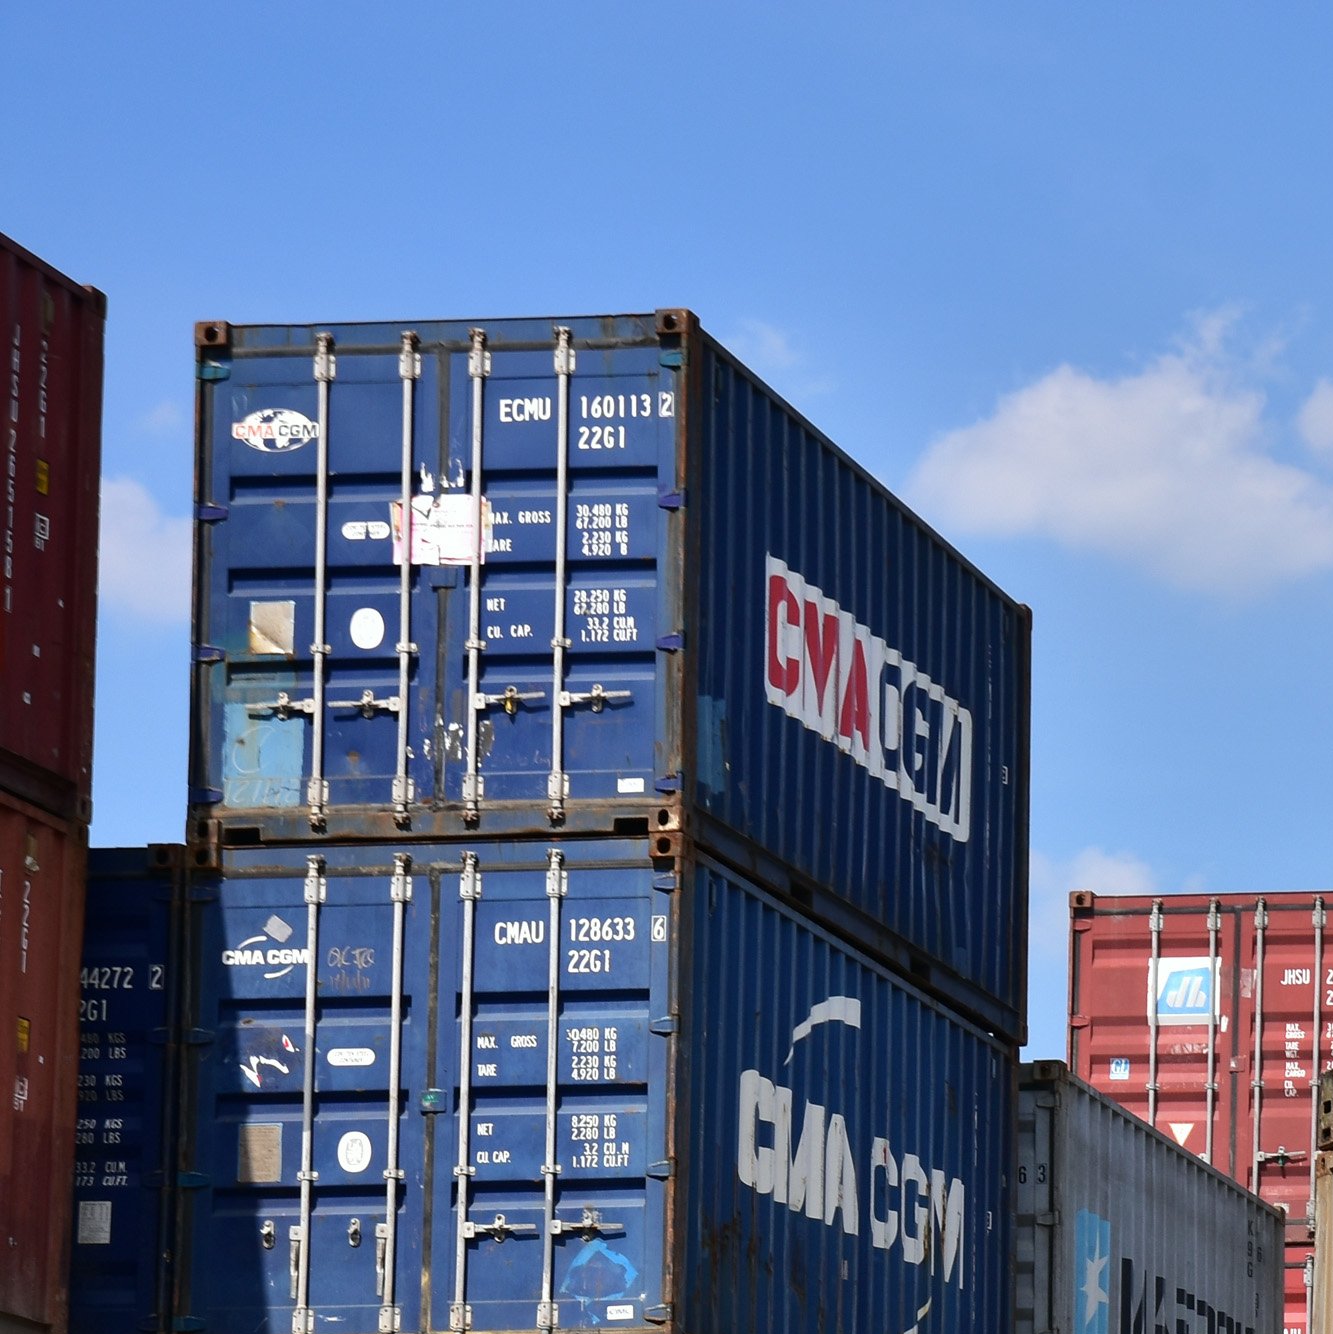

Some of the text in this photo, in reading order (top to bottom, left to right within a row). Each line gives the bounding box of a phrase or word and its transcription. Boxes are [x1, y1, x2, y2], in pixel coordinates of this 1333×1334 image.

[500, 392, 673, 422] ECMU 160113 2
[235, 423, 318, 438] CMA CGM
[578, 426, 626, 449] 22G1
[576, 503, 628, 516] 30.480 KG
[518, 511, 551, 524] GROSS
[576, 516, 628, 529] 67.200 LB
[582, 531, 628, 544] 2.230 KG
[582, 544, 611, 556] 4.920
[574, 589, 626, 602] 28.250 KG
[487, 598, 505, 611] NET
[613, 602, 626, 614] LB
[587, 617, 609, 630] 33.2
[581, 629, 609, 642] 1.172
[494, 917, 665, 944] CMAU 128633 6
[222, 950, 265, 965] CMA
[267, 949, 309, 965] CGM
[567, 949, 610, 973] 22G1
[1280, 968, 1310, 985] JHSU
[604, 1028, 617, 1040] KG
[477, 1035, 537, 1049] MAX. GROSS
[604, 1040, 616, 1052] LB
[571, 1055, 617, 1068] 2.230 KG
[477, 1064, 497, 1077] TARE
[571, 1068, 616, 1081] 4.920 LB
[604, 1115, 617, 1126] KG
[477, 1123, 493, 1135] NET
[603, 1128, 616, 1139] LB
[738, 1068, 859, 1236] CMA
[572, 1155, 598, 1168] 1.172
